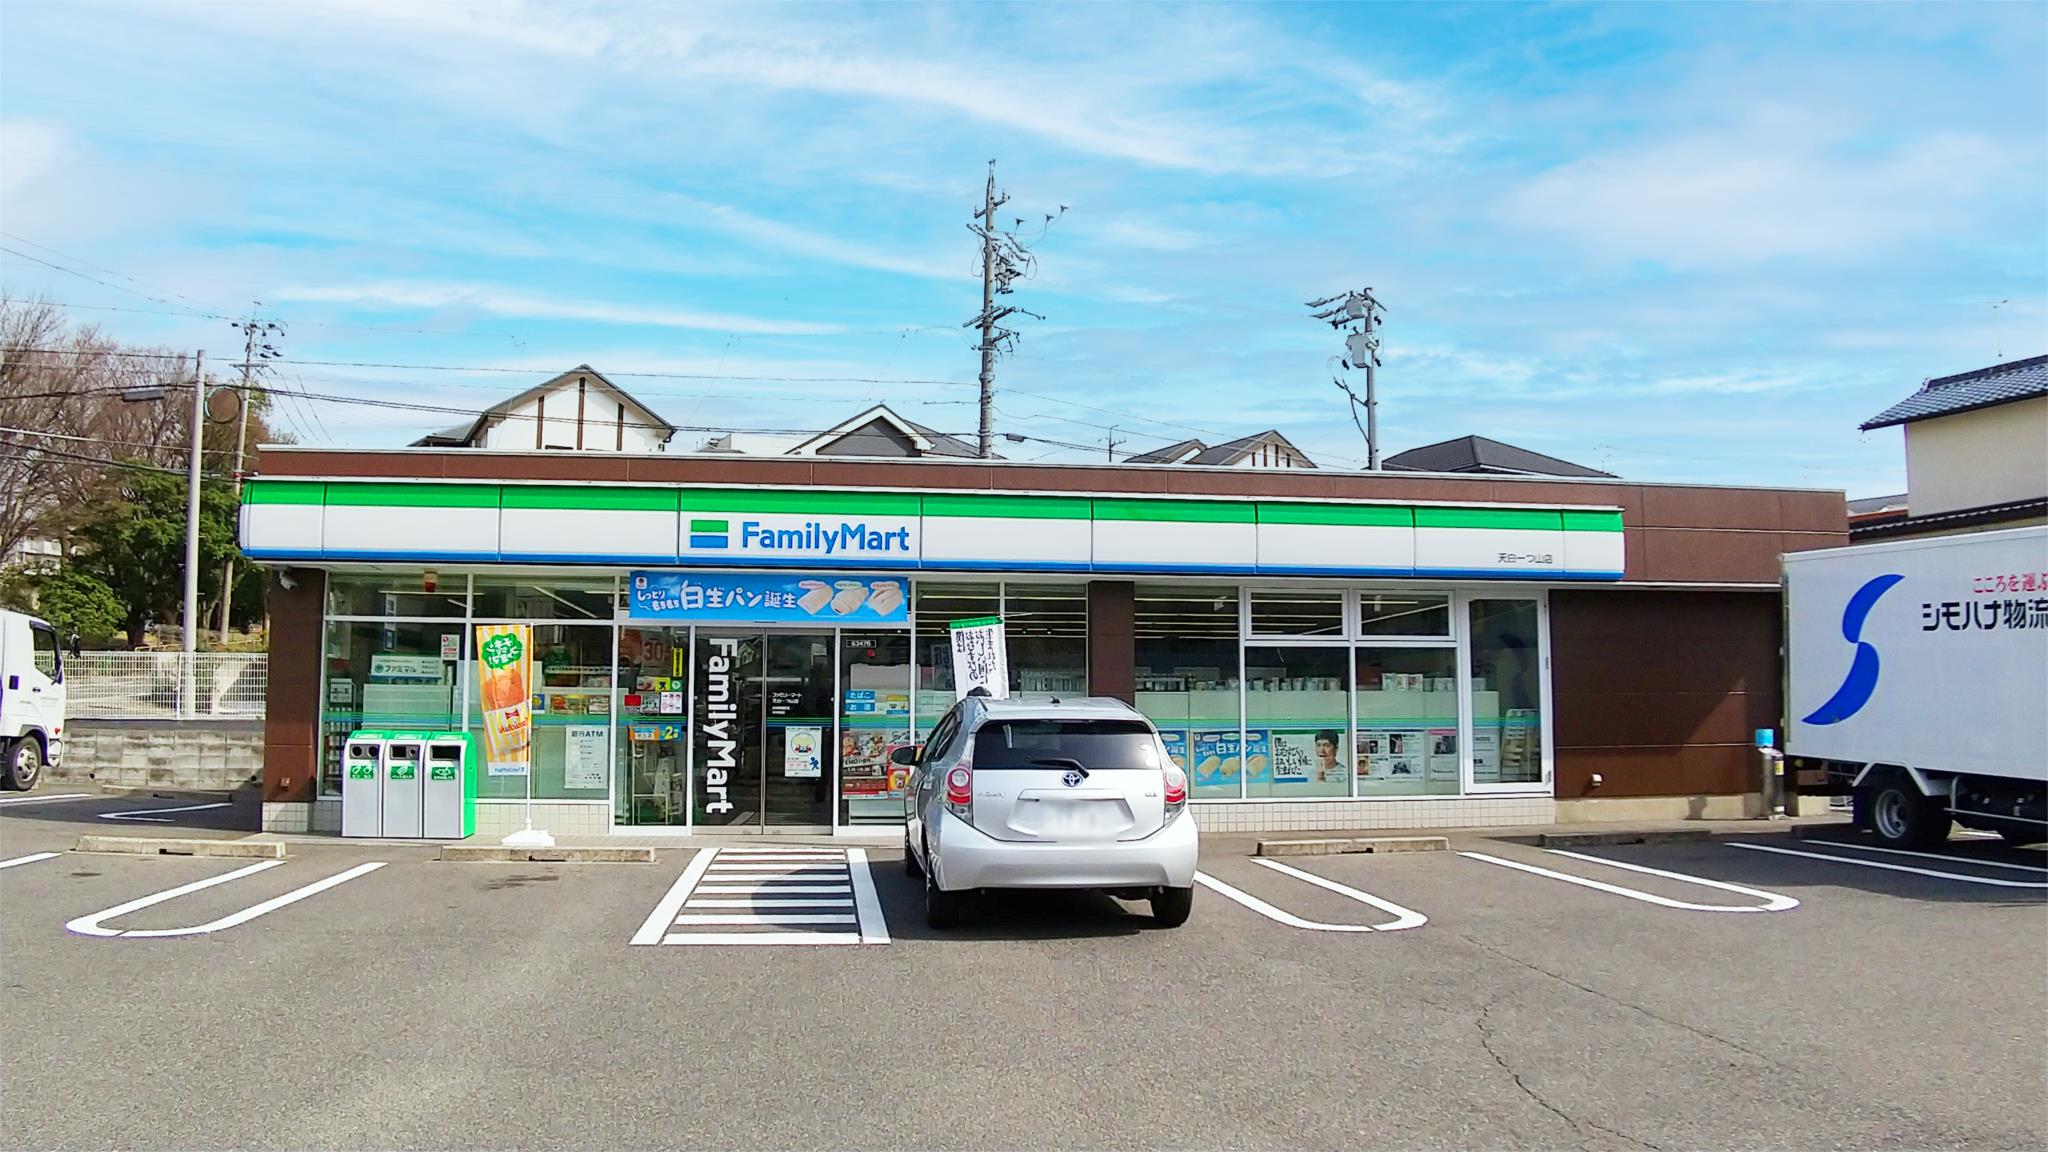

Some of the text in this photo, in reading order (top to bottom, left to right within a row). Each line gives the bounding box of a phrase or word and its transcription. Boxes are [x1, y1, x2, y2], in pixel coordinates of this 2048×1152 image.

[742, 521, 910, 554] FamilyMart
[1497, 552, 1553, 564] 天白一つ山店
[637, 590, 665, 602] しっとり
[680, 580, 797, 610] 白生パン誕生
[1922, 597, 2048, 631] シモハナ物流
[384, 665, 417, 673] ファミマル
[850, 692, 871, 700] たばこ
[702, 638, 738, 814] FamilyMart
